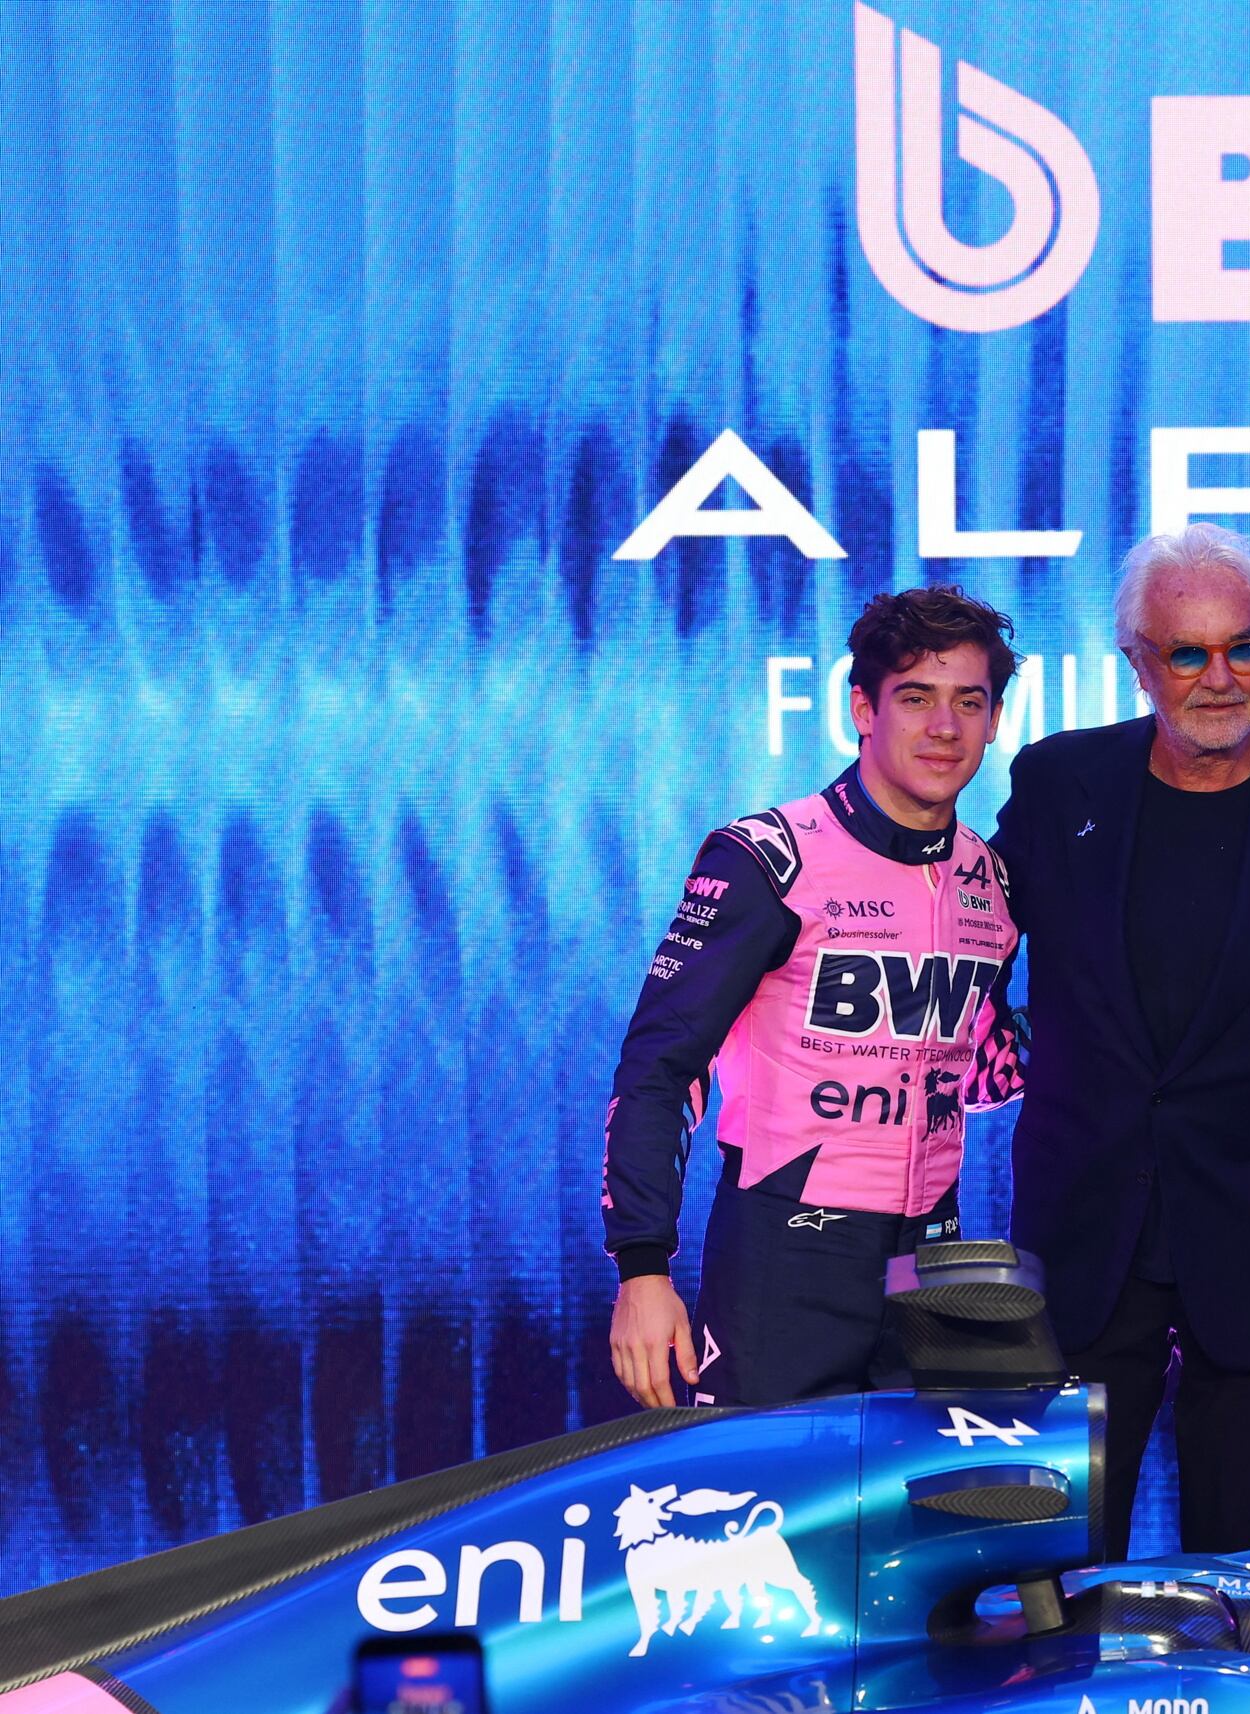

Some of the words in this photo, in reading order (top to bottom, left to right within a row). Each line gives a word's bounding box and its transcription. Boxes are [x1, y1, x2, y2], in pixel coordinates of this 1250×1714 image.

[846, 900, 896, 917] MSC
[841, 928, 900, 940] businessolver
[652, 966, 675, 980] WOLF
[655, 954, 683, 971] ARCTIC
[804, 948, 1003, 1043] BWT
[801, 1036, 847, 1054] BEST
[852, 1044, 910, 1061] WATER
[810, 1073, 911, 1126] eni
[356, 1502, 592, 1632] eni
